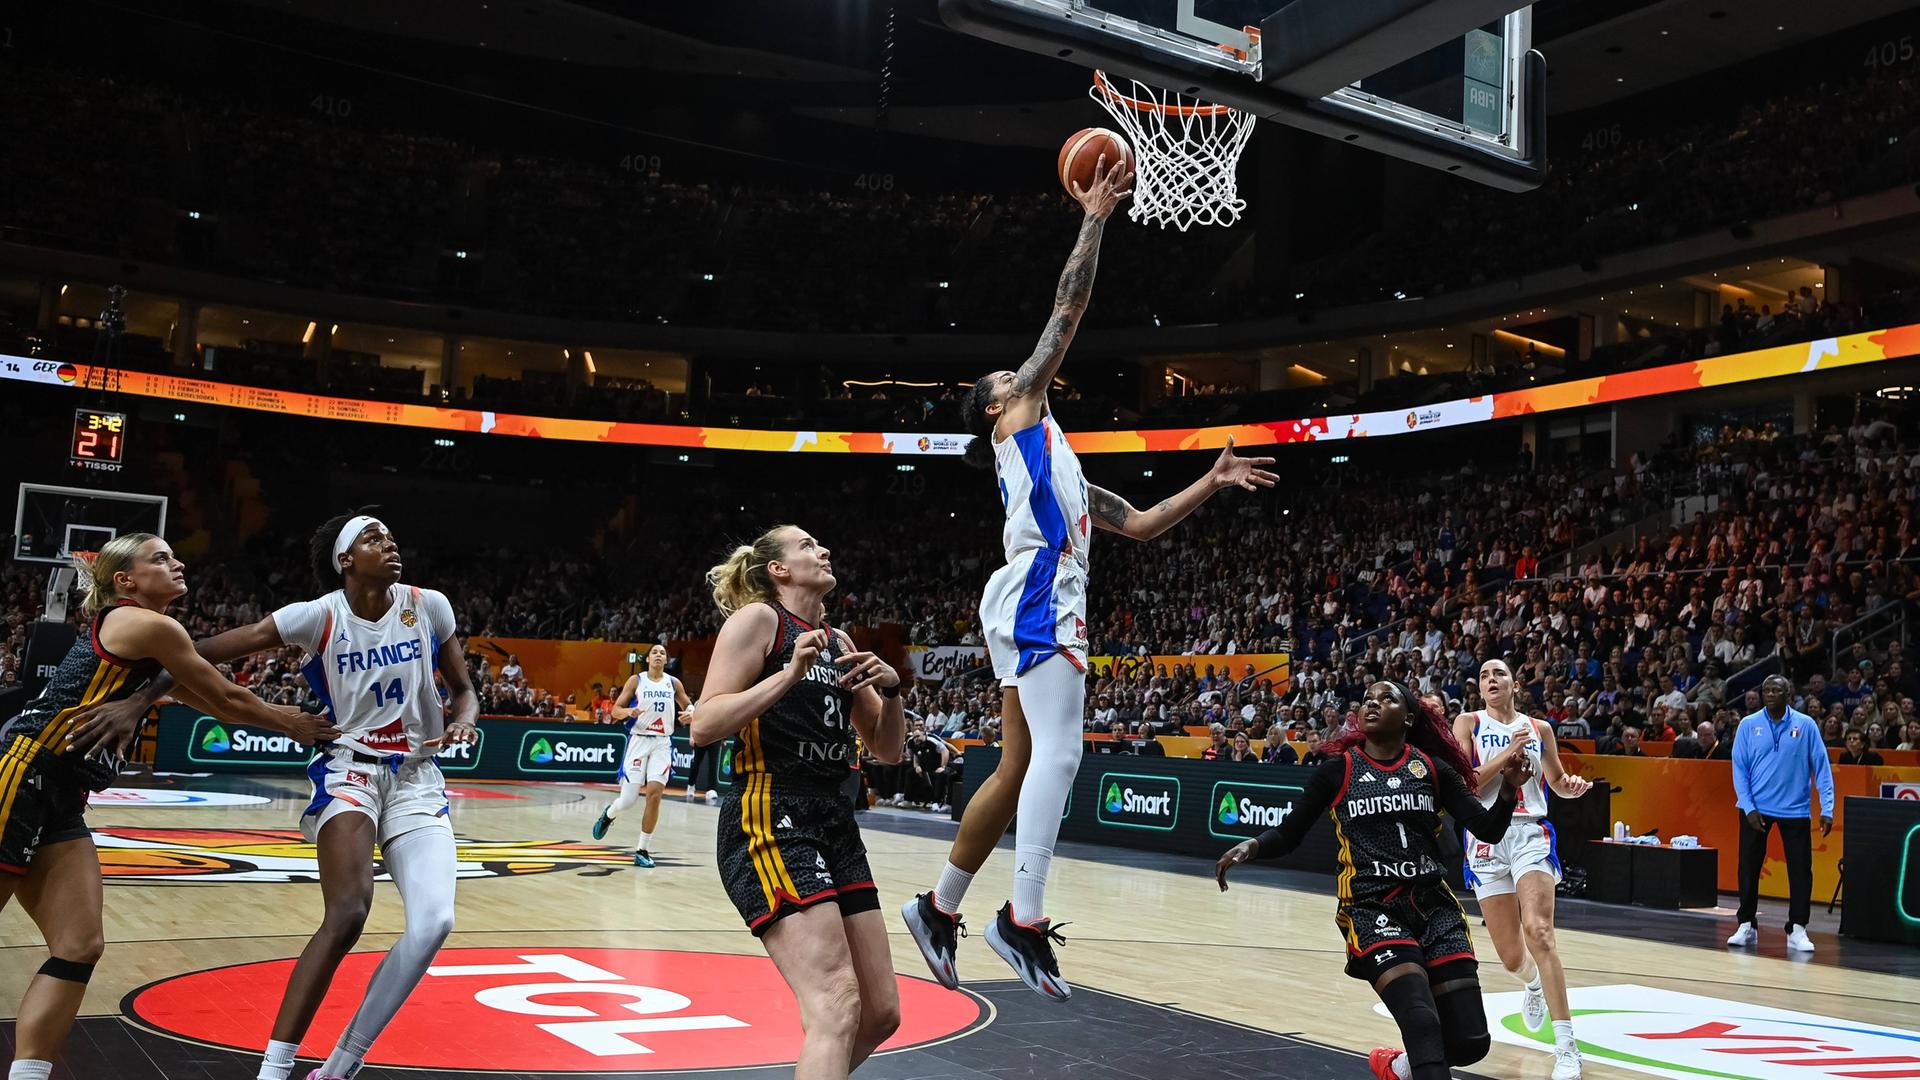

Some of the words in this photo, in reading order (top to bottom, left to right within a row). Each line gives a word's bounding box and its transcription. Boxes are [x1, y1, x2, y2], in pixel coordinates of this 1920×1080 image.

[1863, 36, 1913, 68] 405
[311, 94, 352, 117] 410
[1581, 123, 1622, 151] 406
[619, 154, 662, 173] 409
[853, 171, 895, 191] 408
[33, 361, 57, 375] GER
[88, 415, 122, 432] 3:42
[78, 431, 117, 458] 21
[84, 461, 122, 472] TISSOT
[337, 638, 422, 675] FRANCE
[36, 664, 58, 679] FIB
[369, 678, 404, 708] 14
[643, 690, 672, 699] FRANCE
[653, 702, 665, 712] 13
[823, 695, 843, 730] 21
[231, 729, 304, 753] Smart
[436, 740, 471, 758] art
[554, 741, 615, 763] Smart
[797, 741, 843, 761] ING
[1481, 734, 1538, 753] FRAE
[672, 747, 695, 769] Smar
[1123, 787, 1170, 816] Smart
[1395, 822, 1408, 849] 1
[1371, 860, 1417, 878] ING
[425, 954, 752, 1057] TCL
